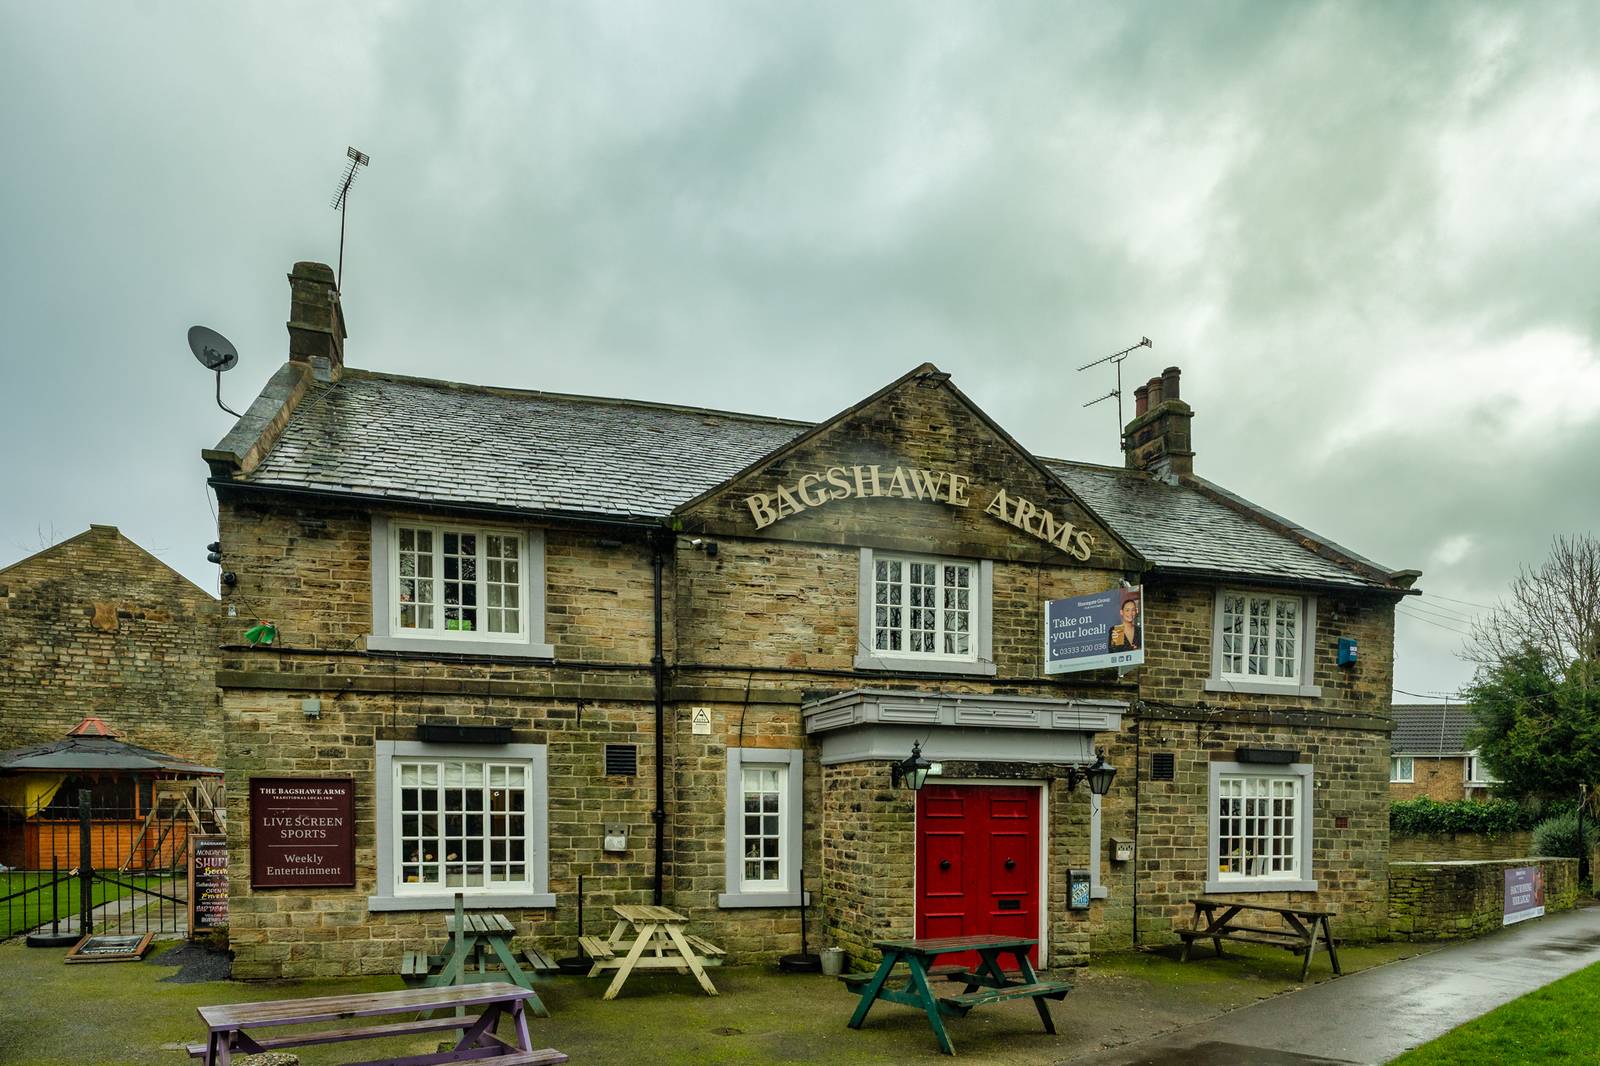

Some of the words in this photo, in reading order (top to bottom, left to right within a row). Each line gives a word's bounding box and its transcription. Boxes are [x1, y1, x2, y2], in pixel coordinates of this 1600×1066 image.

[743, 465, 970, 531] BAGSHAWE
[984, 489, 1095, 562] ARMS
[1052, 616, 1077, 629] Take
[1078, 615, 1092, 624] on
[1052, 630, 1077, 643] your
[1078, 624, 1106, 638] local!
[1060, 646, 1080, 656] 03333
[1080, 644, 1093, 653] 200
[1094, 643, 1107, 651] 036
[260, 787, 277, 795] THE
[263, 817, 293, 827] LIVE
[294, 817, 343, 827] SCREEN
[280, 829, 327, 839] SPORTS
[284, 853, 323, 865] Weekly
[266, 866, 341, 876] Entertainment
